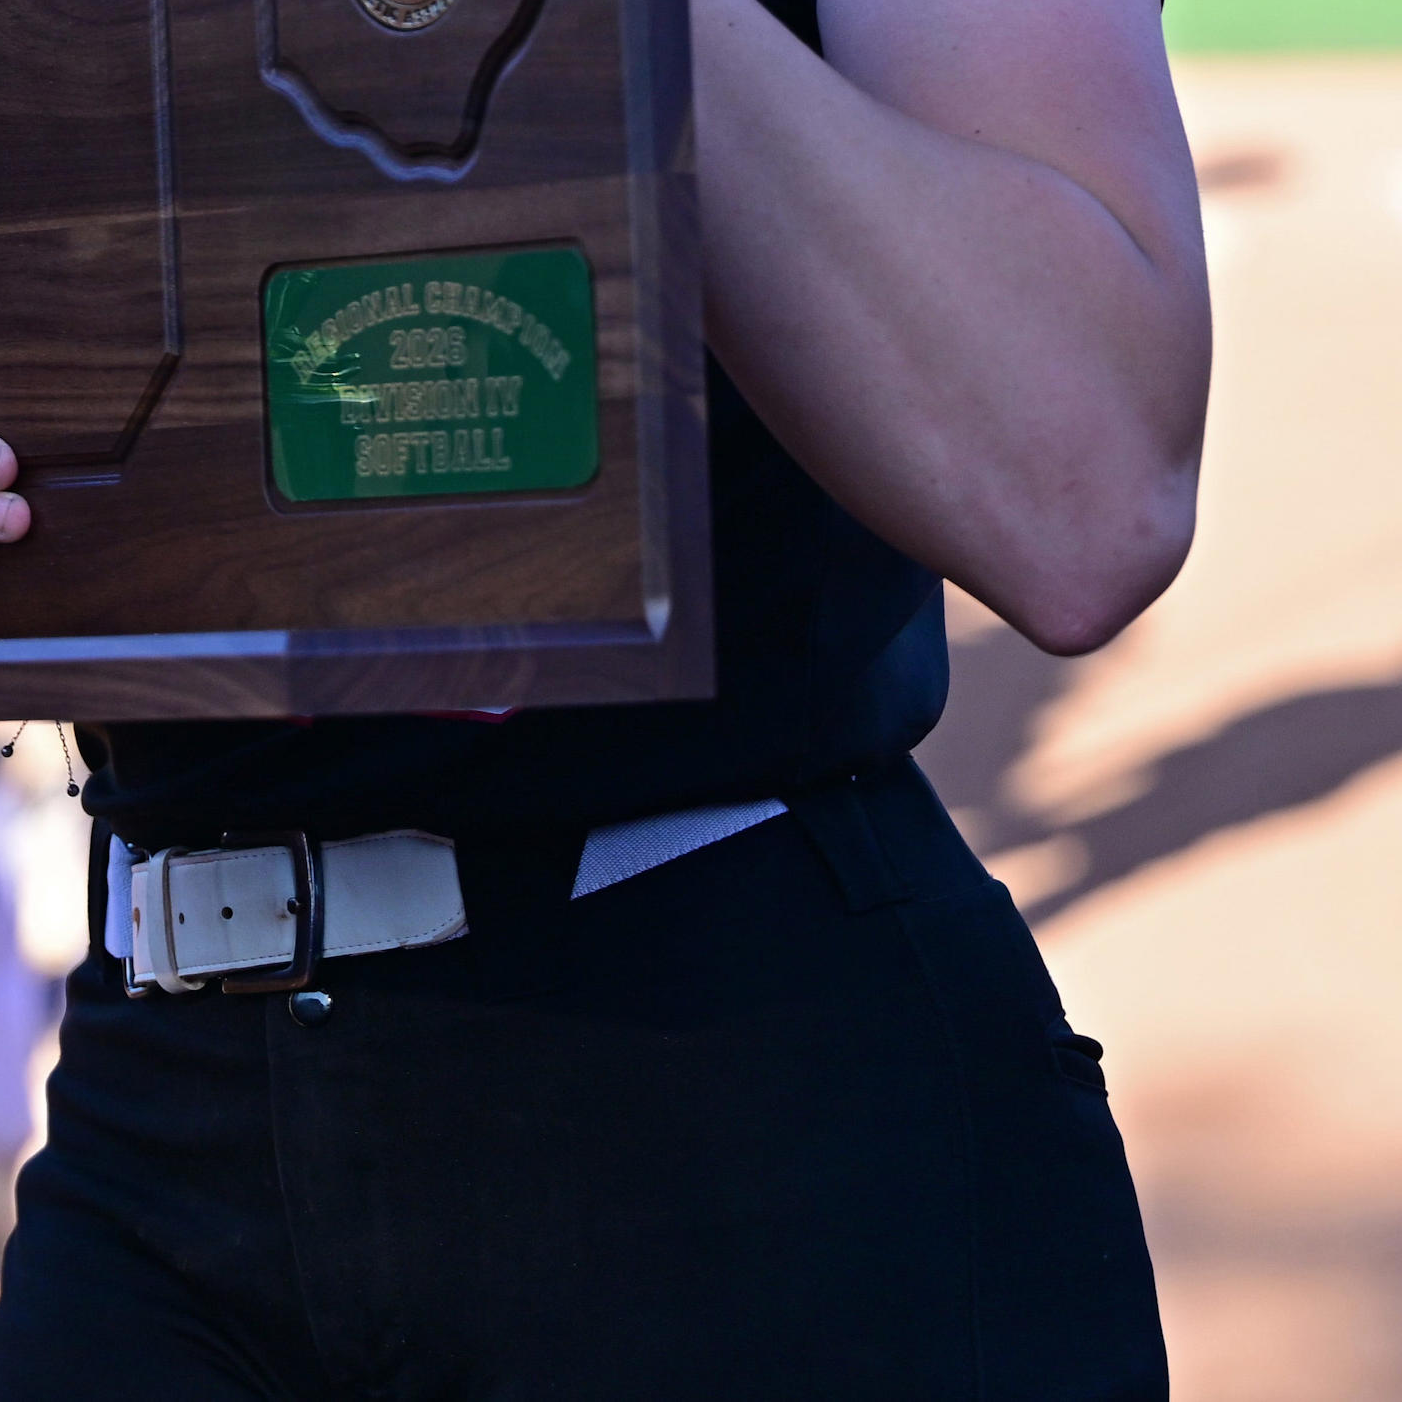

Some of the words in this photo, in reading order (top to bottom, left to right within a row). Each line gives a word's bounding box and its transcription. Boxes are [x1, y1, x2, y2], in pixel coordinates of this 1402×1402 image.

[291, 282, 422, 384] REGIONAL
[423, 280, 572, 382] CHAMPION
[339, 378, 479, 425] DIVISION
[484, 375, 523, 417] IV
[354, 427, 511, 477] SOFTBALL
